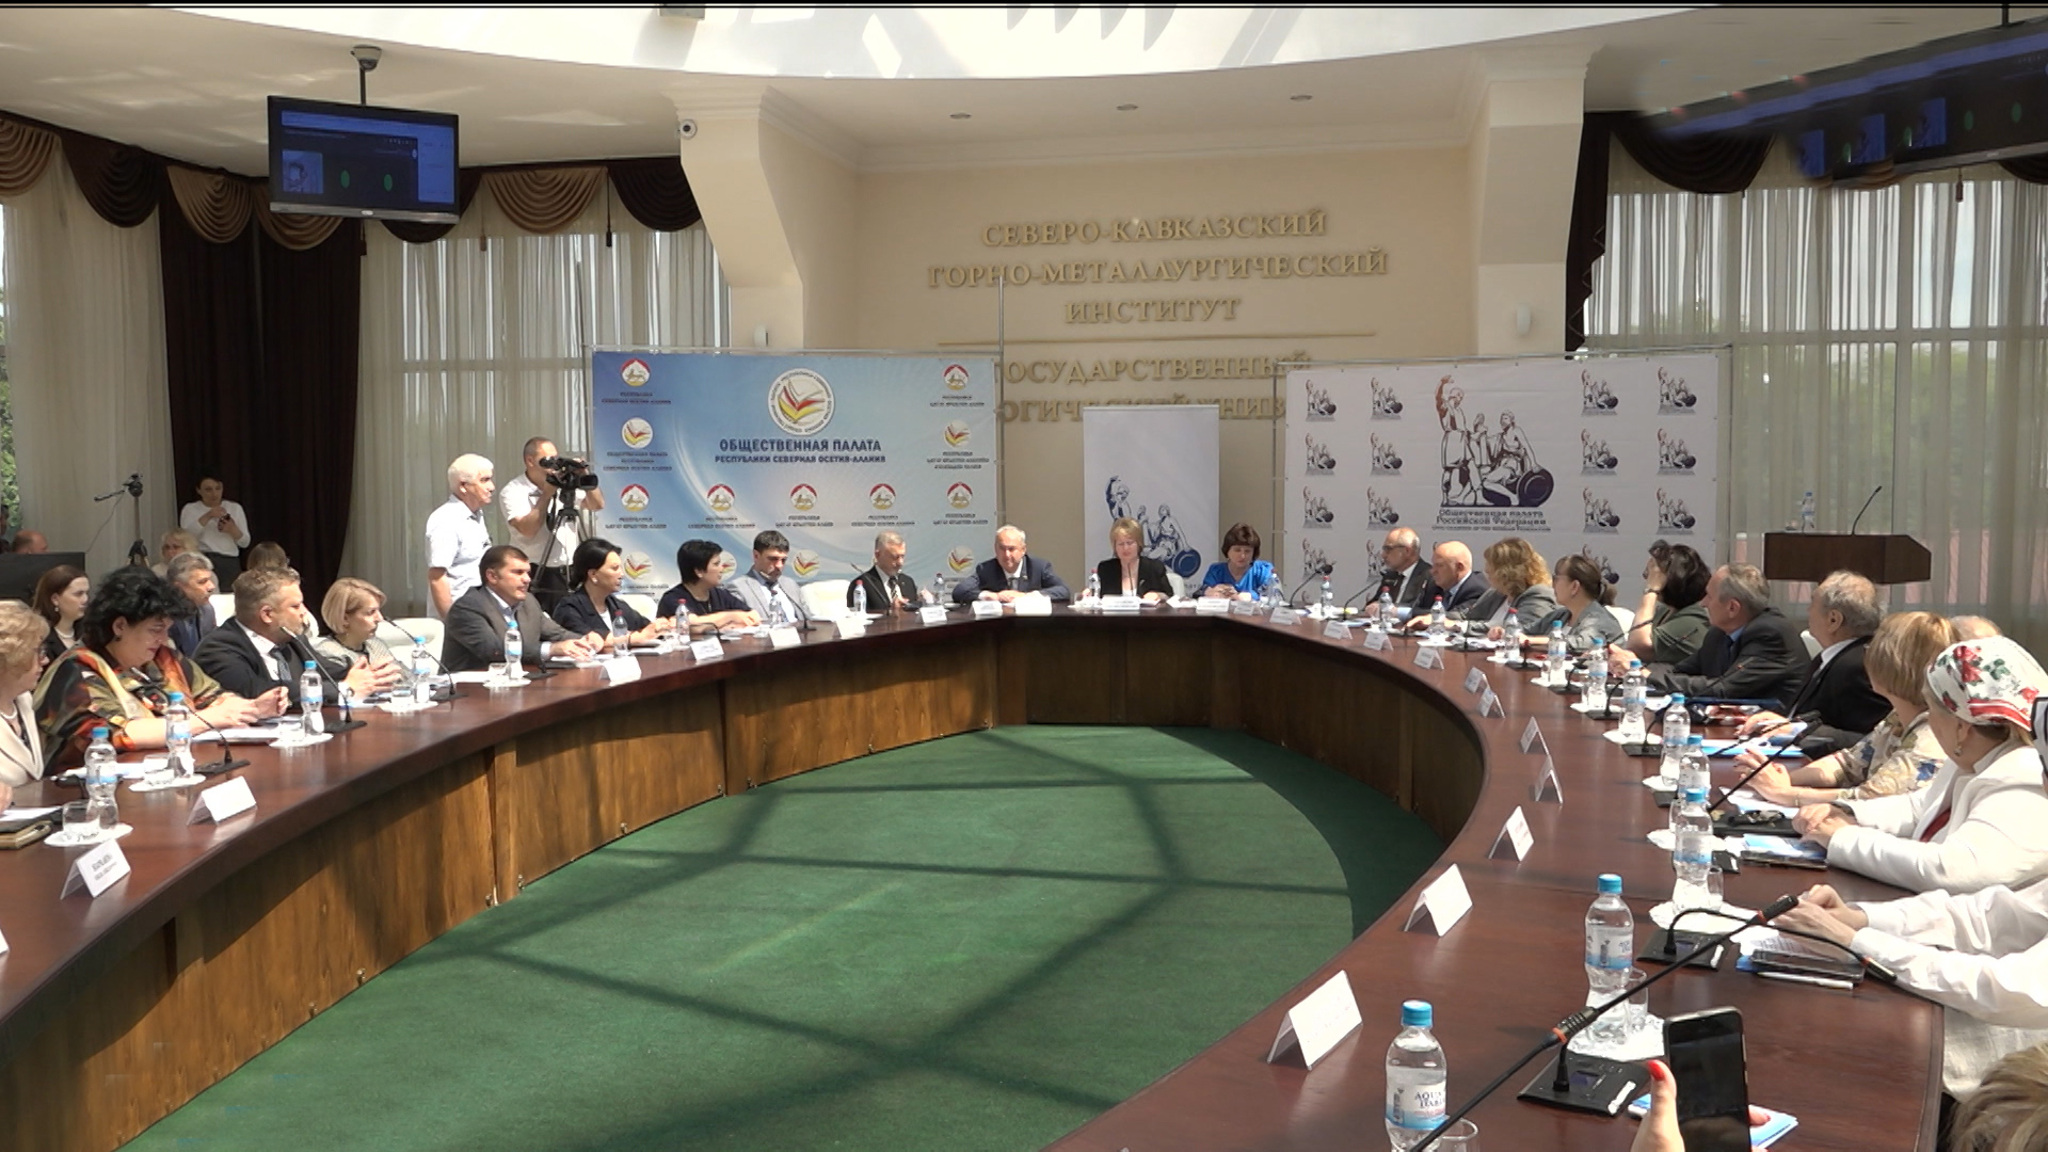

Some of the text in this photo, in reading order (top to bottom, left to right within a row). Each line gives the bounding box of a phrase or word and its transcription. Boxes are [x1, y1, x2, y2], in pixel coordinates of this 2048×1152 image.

[982, 208, 1326, 247] СЕВЕРО-КАВКАЗСКИЙ
[927, 246, 1387, 288] ГОРНО-МЕТАЛЛУРГИЧЕСКИЙ
[1065, 297, 1241, 324] ИНСТИТУТ
[719, 438, 882, 453] ОБЩЕСТВЕННАЯ ПАЛАТА
